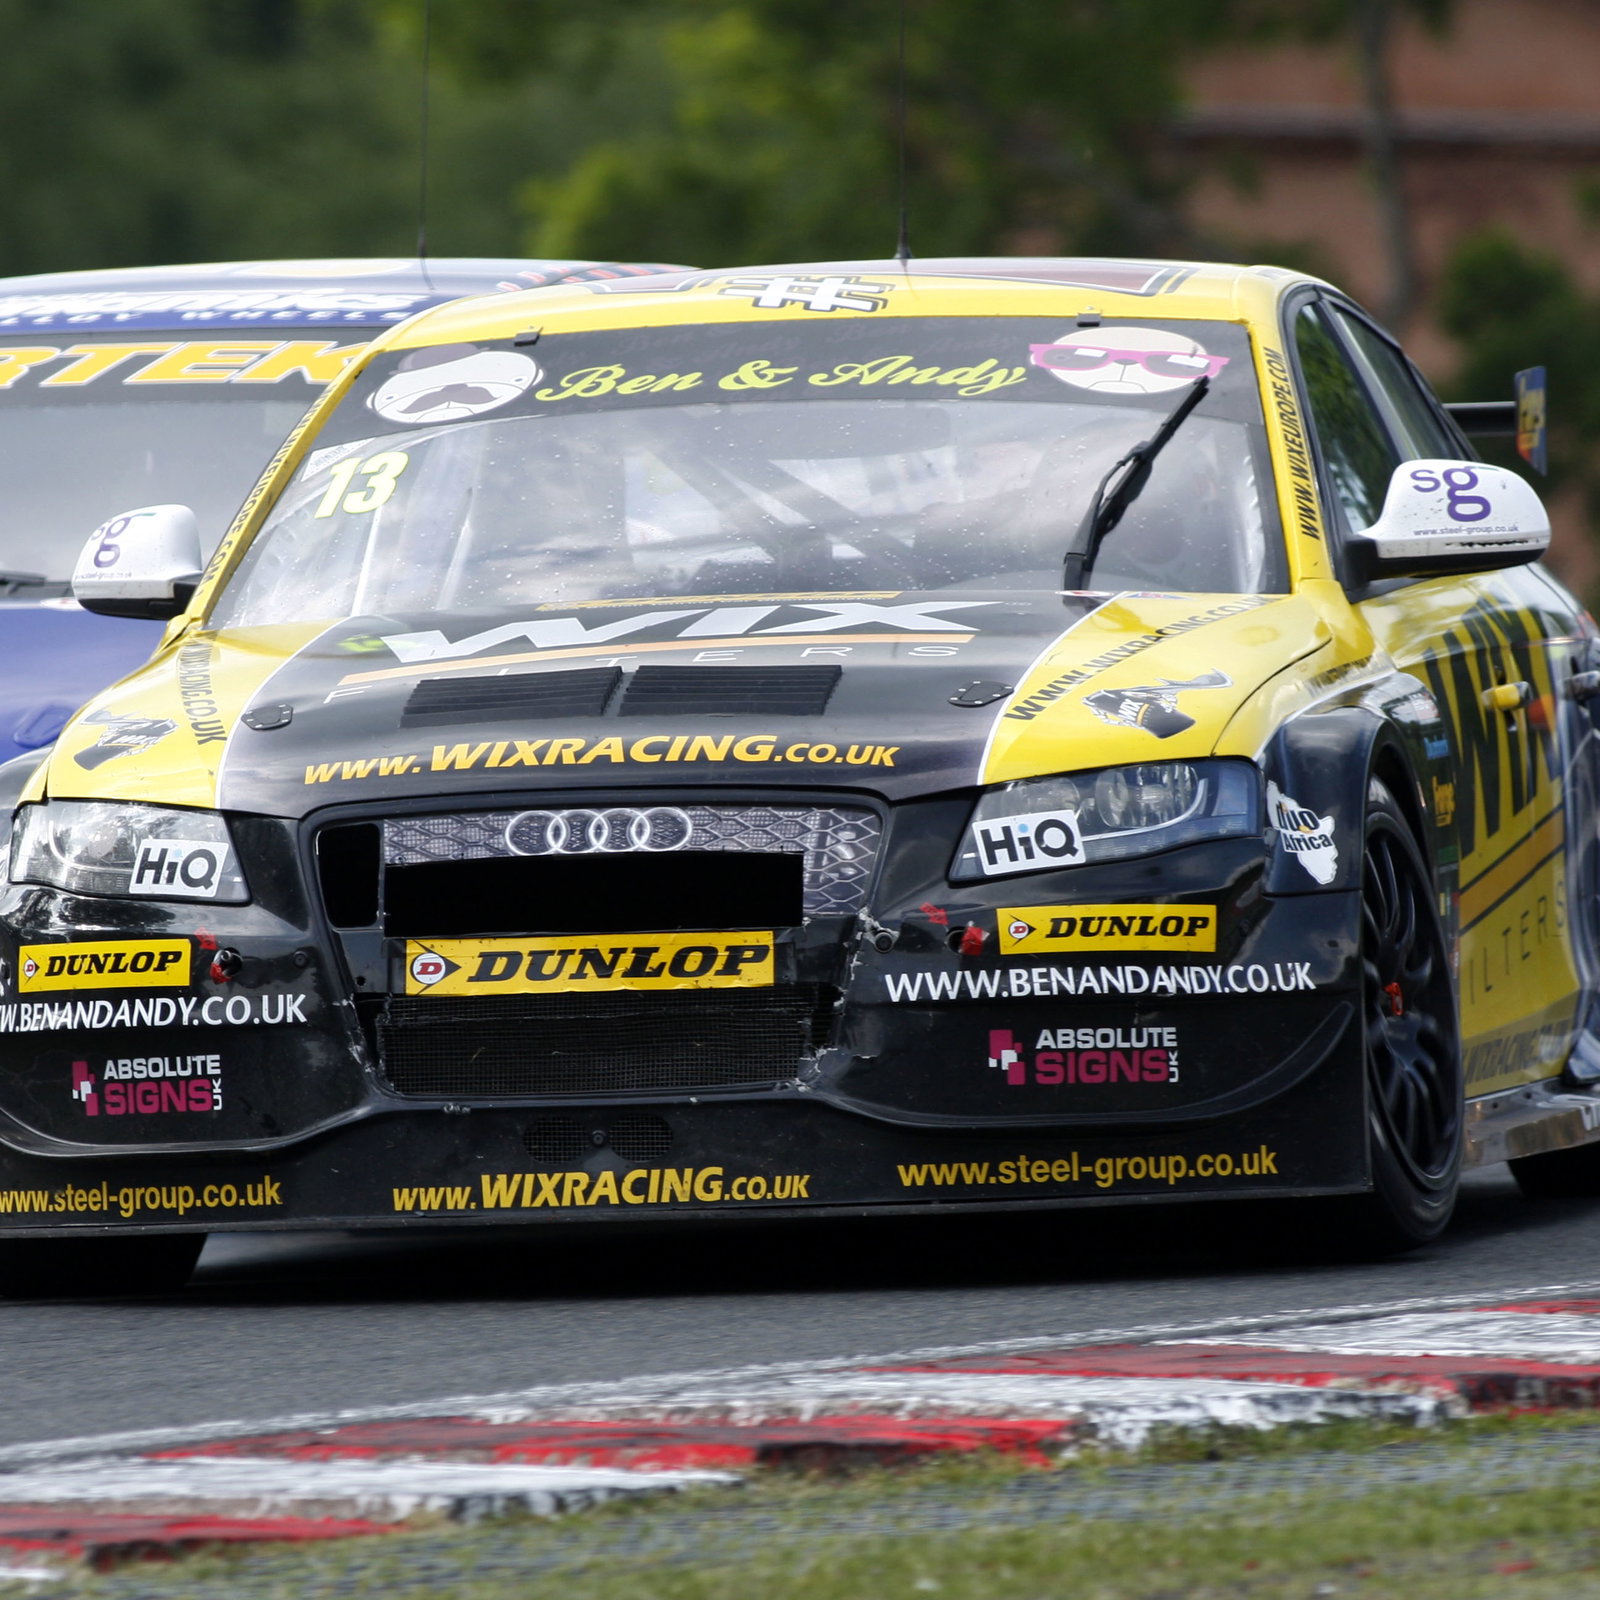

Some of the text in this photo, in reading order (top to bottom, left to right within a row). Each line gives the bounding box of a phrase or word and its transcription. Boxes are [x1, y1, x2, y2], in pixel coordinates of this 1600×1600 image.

[535, 355, 1026, 401] Ben & Andy
[1264, 347, 1320, 541] WWW.WIXEUROPE.COM
[314, 451, 409, 519] 13
[1410, 466, 1491, 522] sg
[1413, 524, 1519, 537] www.steel-group.co.uk
[381, 602, 1000, 664] WIX
[979, 818, 1079, 867] HiQ
[1282, 834, 1333, 851] Africa
[135, 846, 218, 891] HiQ
[1045, 916, 1210, 938] DUNLOP
[45, 951, 183, 976] DUNLOP
[467, 944, 770, 983] DUNLOP
[885, 962, 1317, 1003] WWW.BENANDANDY.CO.UK
[1035, 1026, 1178, 1050] ABSOLUTE
[103, 1054, 221, 1080] ABSOLUTE
[1035, 1049, 1180, 1085] SIGNS UK
[104, 1077, 222, 1116] SIGNS UK
[897, 1145, 1279, 1188] www.steel-group.co.uk
[0, 1175, 283, 1218] www.steel-group.co.uk
